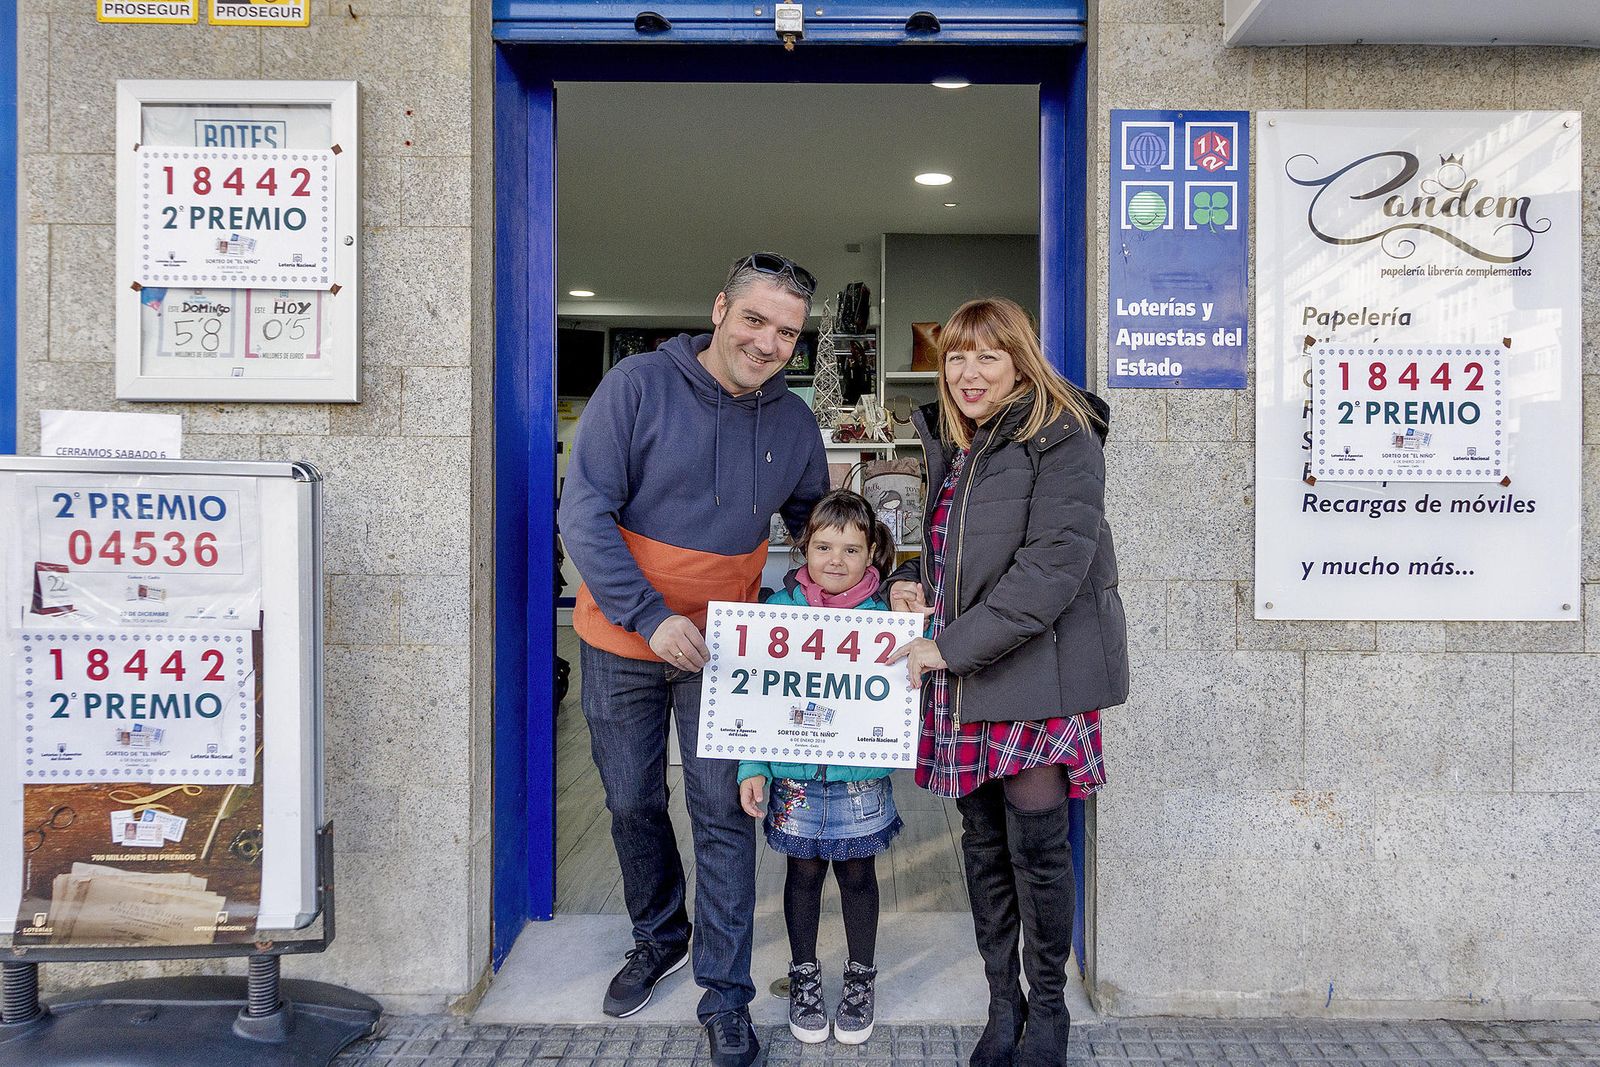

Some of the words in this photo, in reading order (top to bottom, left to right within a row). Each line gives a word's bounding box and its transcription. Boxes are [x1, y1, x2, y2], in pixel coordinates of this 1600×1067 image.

[104, 4, 190, 16] PROSEGUR
[216, 6, 302, 18] PROSEGUR
[190, 206, 307, 231] PREMIO
[1380, 264, 1425, 278] papelería
[1427, 264, 1463, 276] librería
[1465, 265, 1532, 278] complementos
[168, 305, 180, 313] ESTE
[254, 306, 266, 314] ESTE
[273, 301, 312, 314] HOY
[1116, 298, 1196, 316] Loterías
[1202, 302, 1214, 321] y
[1302, 306, 1412, 331] Papelería
[1116, 328, 1206, 350] Apuestas
[1212, 328, 1242, 346] del
[1116, 358, 1183, 376] Estado
[1366, 401, 1481, 425] PREMIO
[56, 447, 112, 458] CERRAMOS
[115, 449, 158, 459] SABADO
[160, 451, 166, 459] 6
[88, 492, 227, 522] PREMIO
[1302, 492, 1407, 518] Recargas
[1415, 493, 1442, 513] de
[1450, 494, 1536, 513] móviles
[68, 529, 219, 568] 04536
[1301, 560, 1314, 580] y
[1321, 556, 1400, 576] mucho
[1408, 556, 1475, 576] más...
[762, 669, 891, 702] PREMIO
[84, 692, 222, 720] PREMIO
